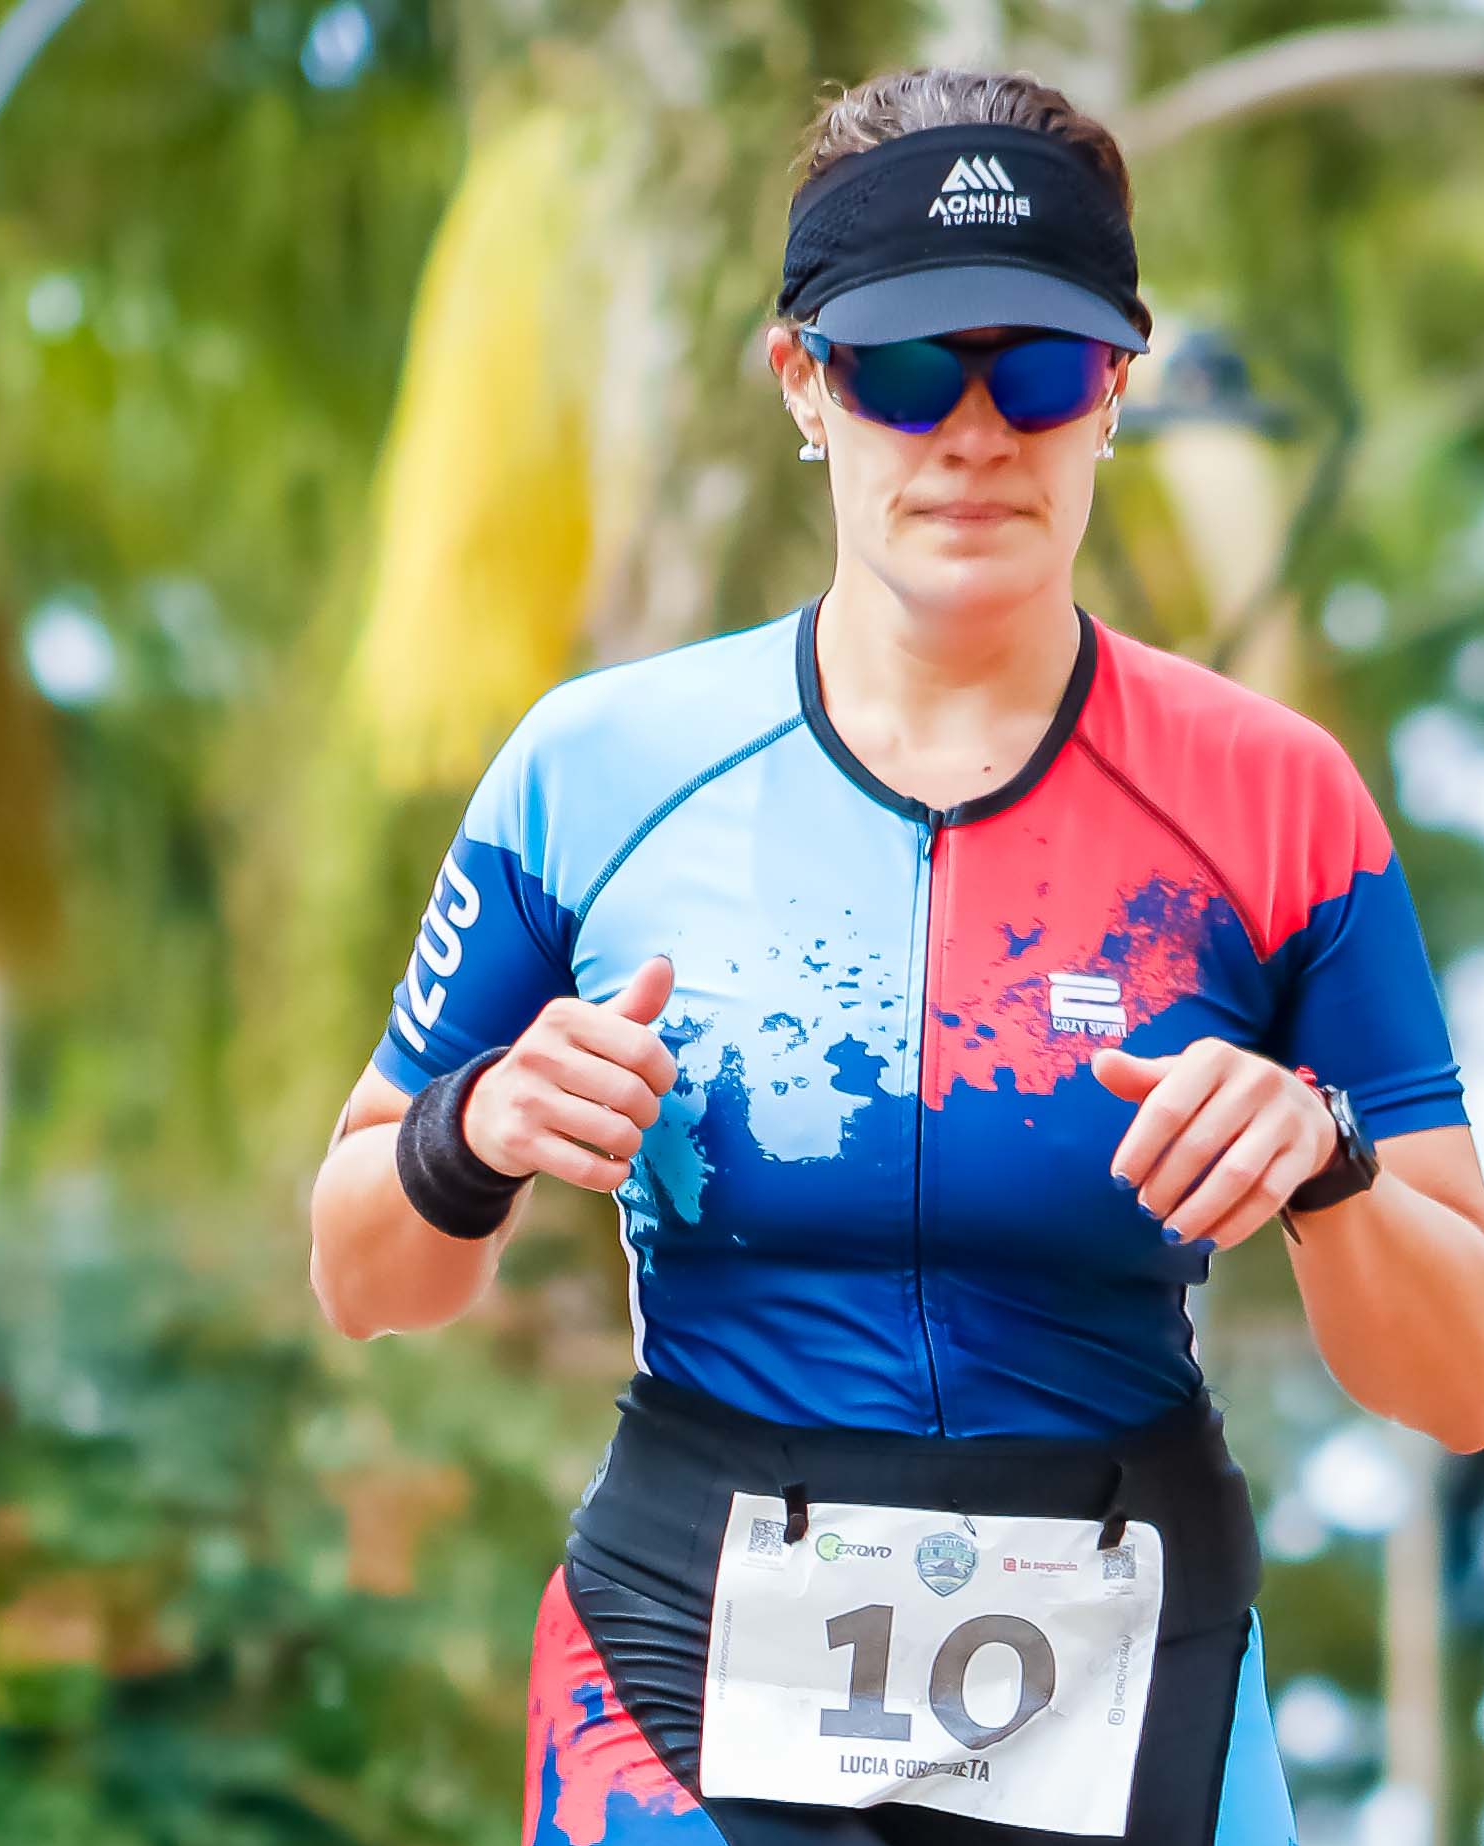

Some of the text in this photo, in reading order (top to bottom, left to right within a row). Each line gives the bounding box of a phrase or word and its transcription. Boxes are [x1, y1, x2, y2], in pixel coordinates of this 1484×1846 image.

[928, 193, 1030, 217] AONIJIE
[1052, 1017, 1085, 1033] COZY
[820, 1604, 1056, 1750] 10
[840, 1755, 889, 1776] LUCIA
